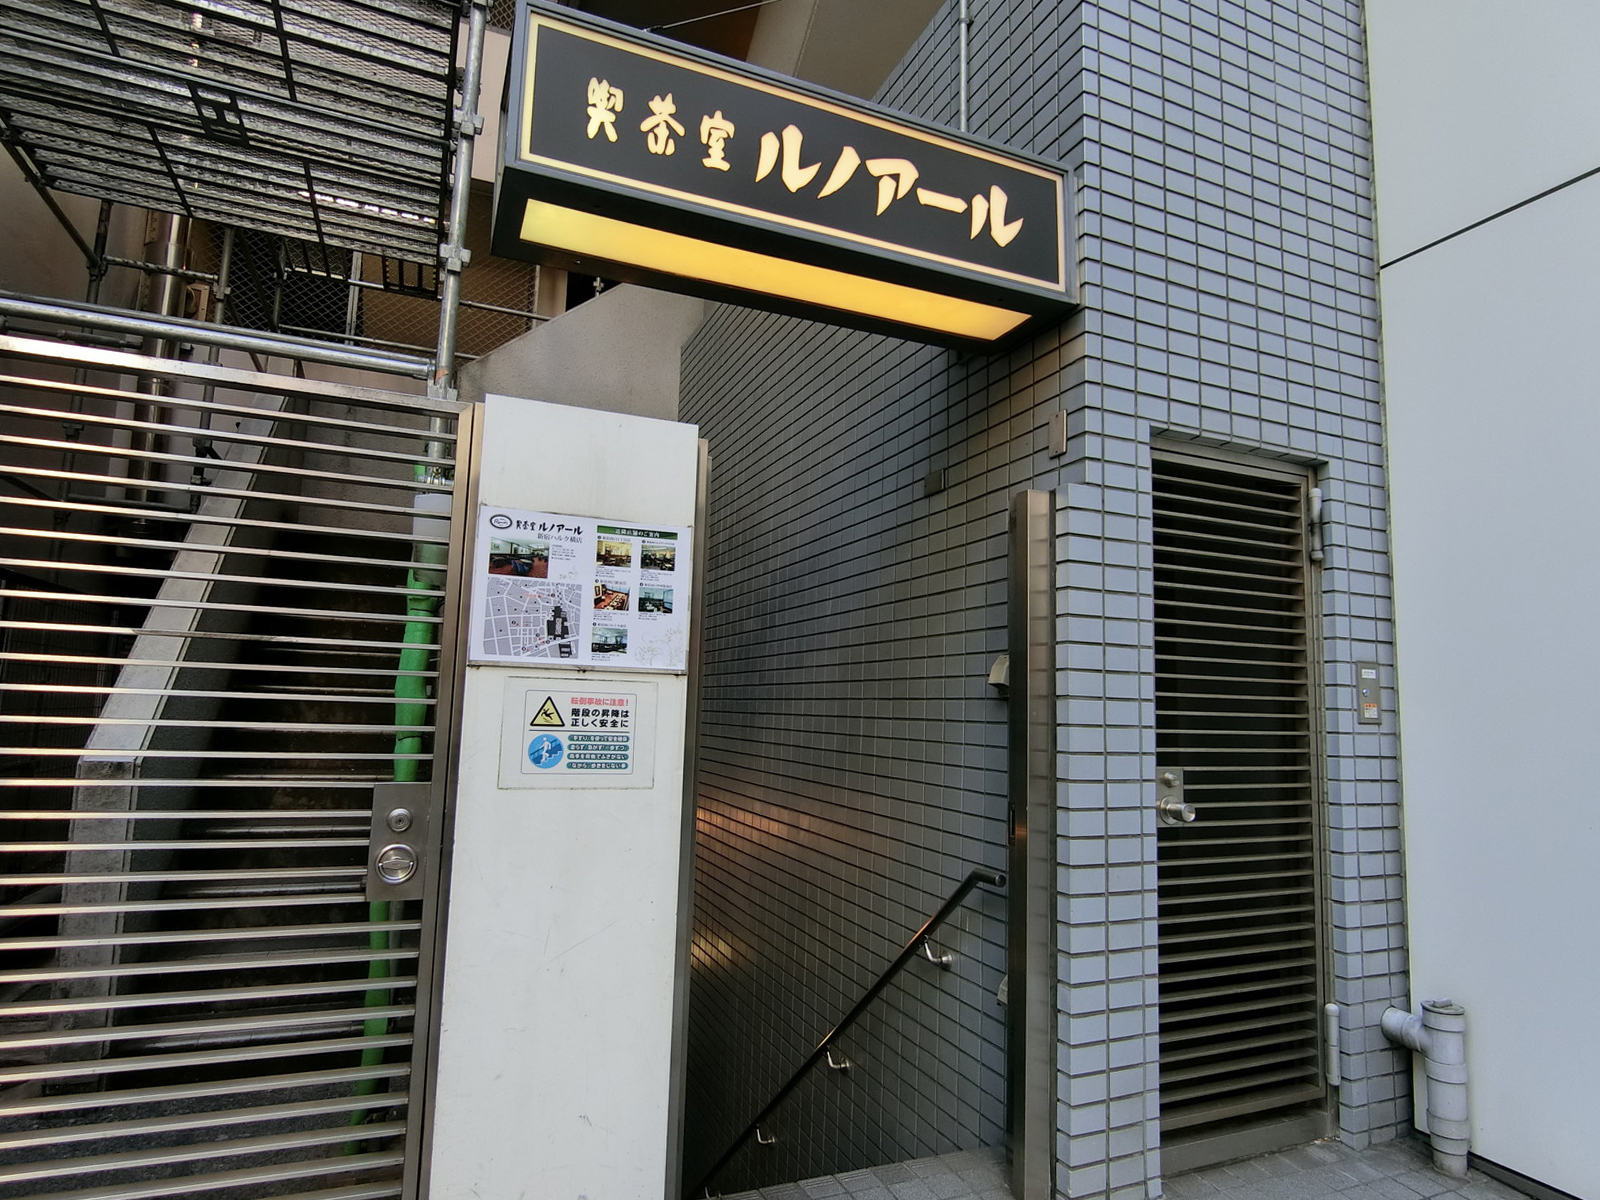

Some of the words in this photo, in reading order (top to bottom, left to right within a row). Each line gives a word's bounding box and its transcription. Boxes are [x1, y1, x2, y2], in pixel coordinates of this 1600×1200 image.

[570, 708, 629, 718] 階段の昇降は
[570, 718, 629, 728] 正しく安全に
